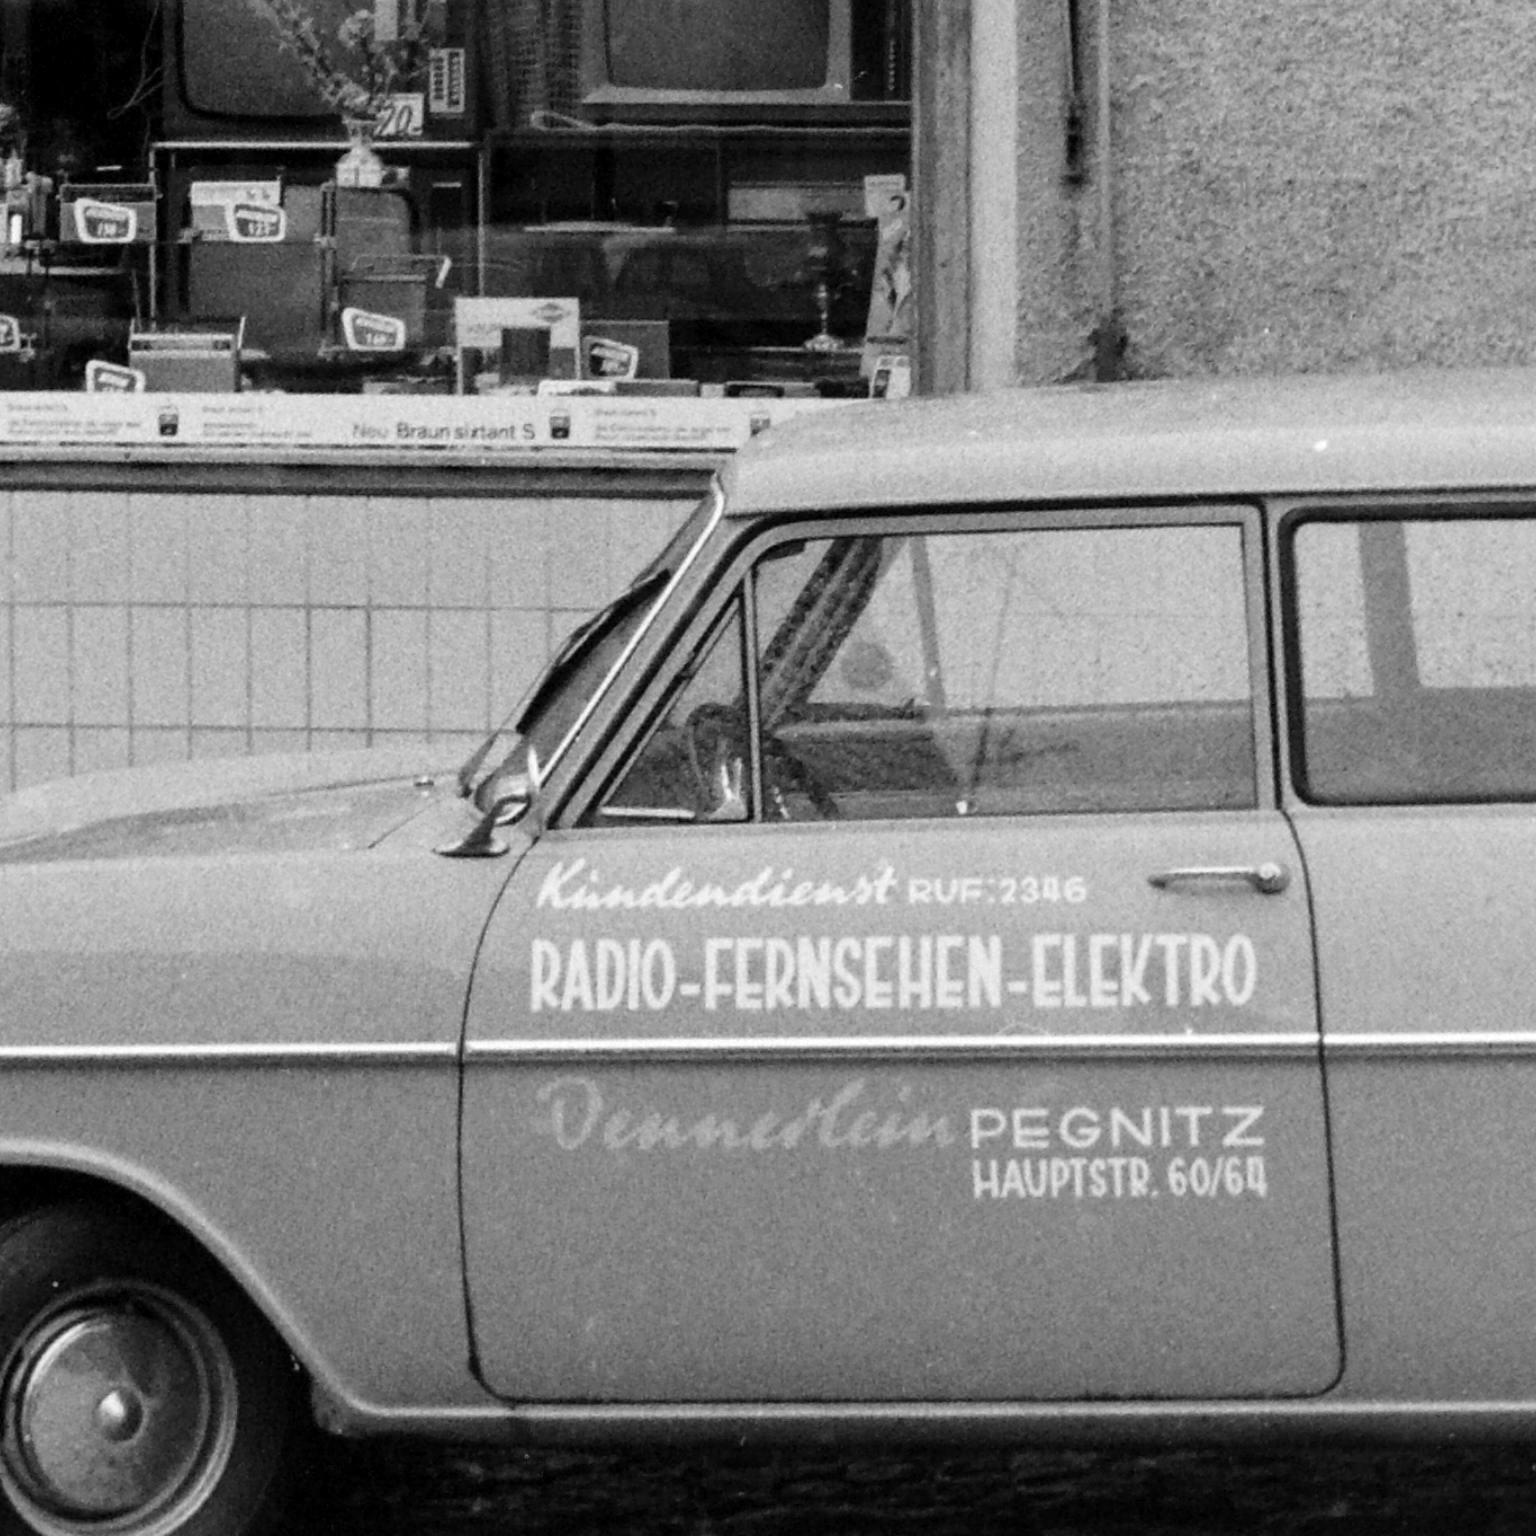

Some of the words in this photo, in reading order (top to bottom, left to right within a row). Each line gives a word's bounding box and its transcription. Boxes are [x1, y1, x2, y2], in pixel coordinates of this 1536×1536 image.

[396, 421, 449, 440] Braun
[528, 932, 1260, 1014] RADIO-FERNSEHEN-ELEKTRO
[535, 1074, 956, 1152] Dennerlein
[969, 1105, 1267, 1150] PEGNITZ
[971, 1155, 1161, 1200] HAUPTSTR.
[1166, 1154, 1270, 1199] 60/64
